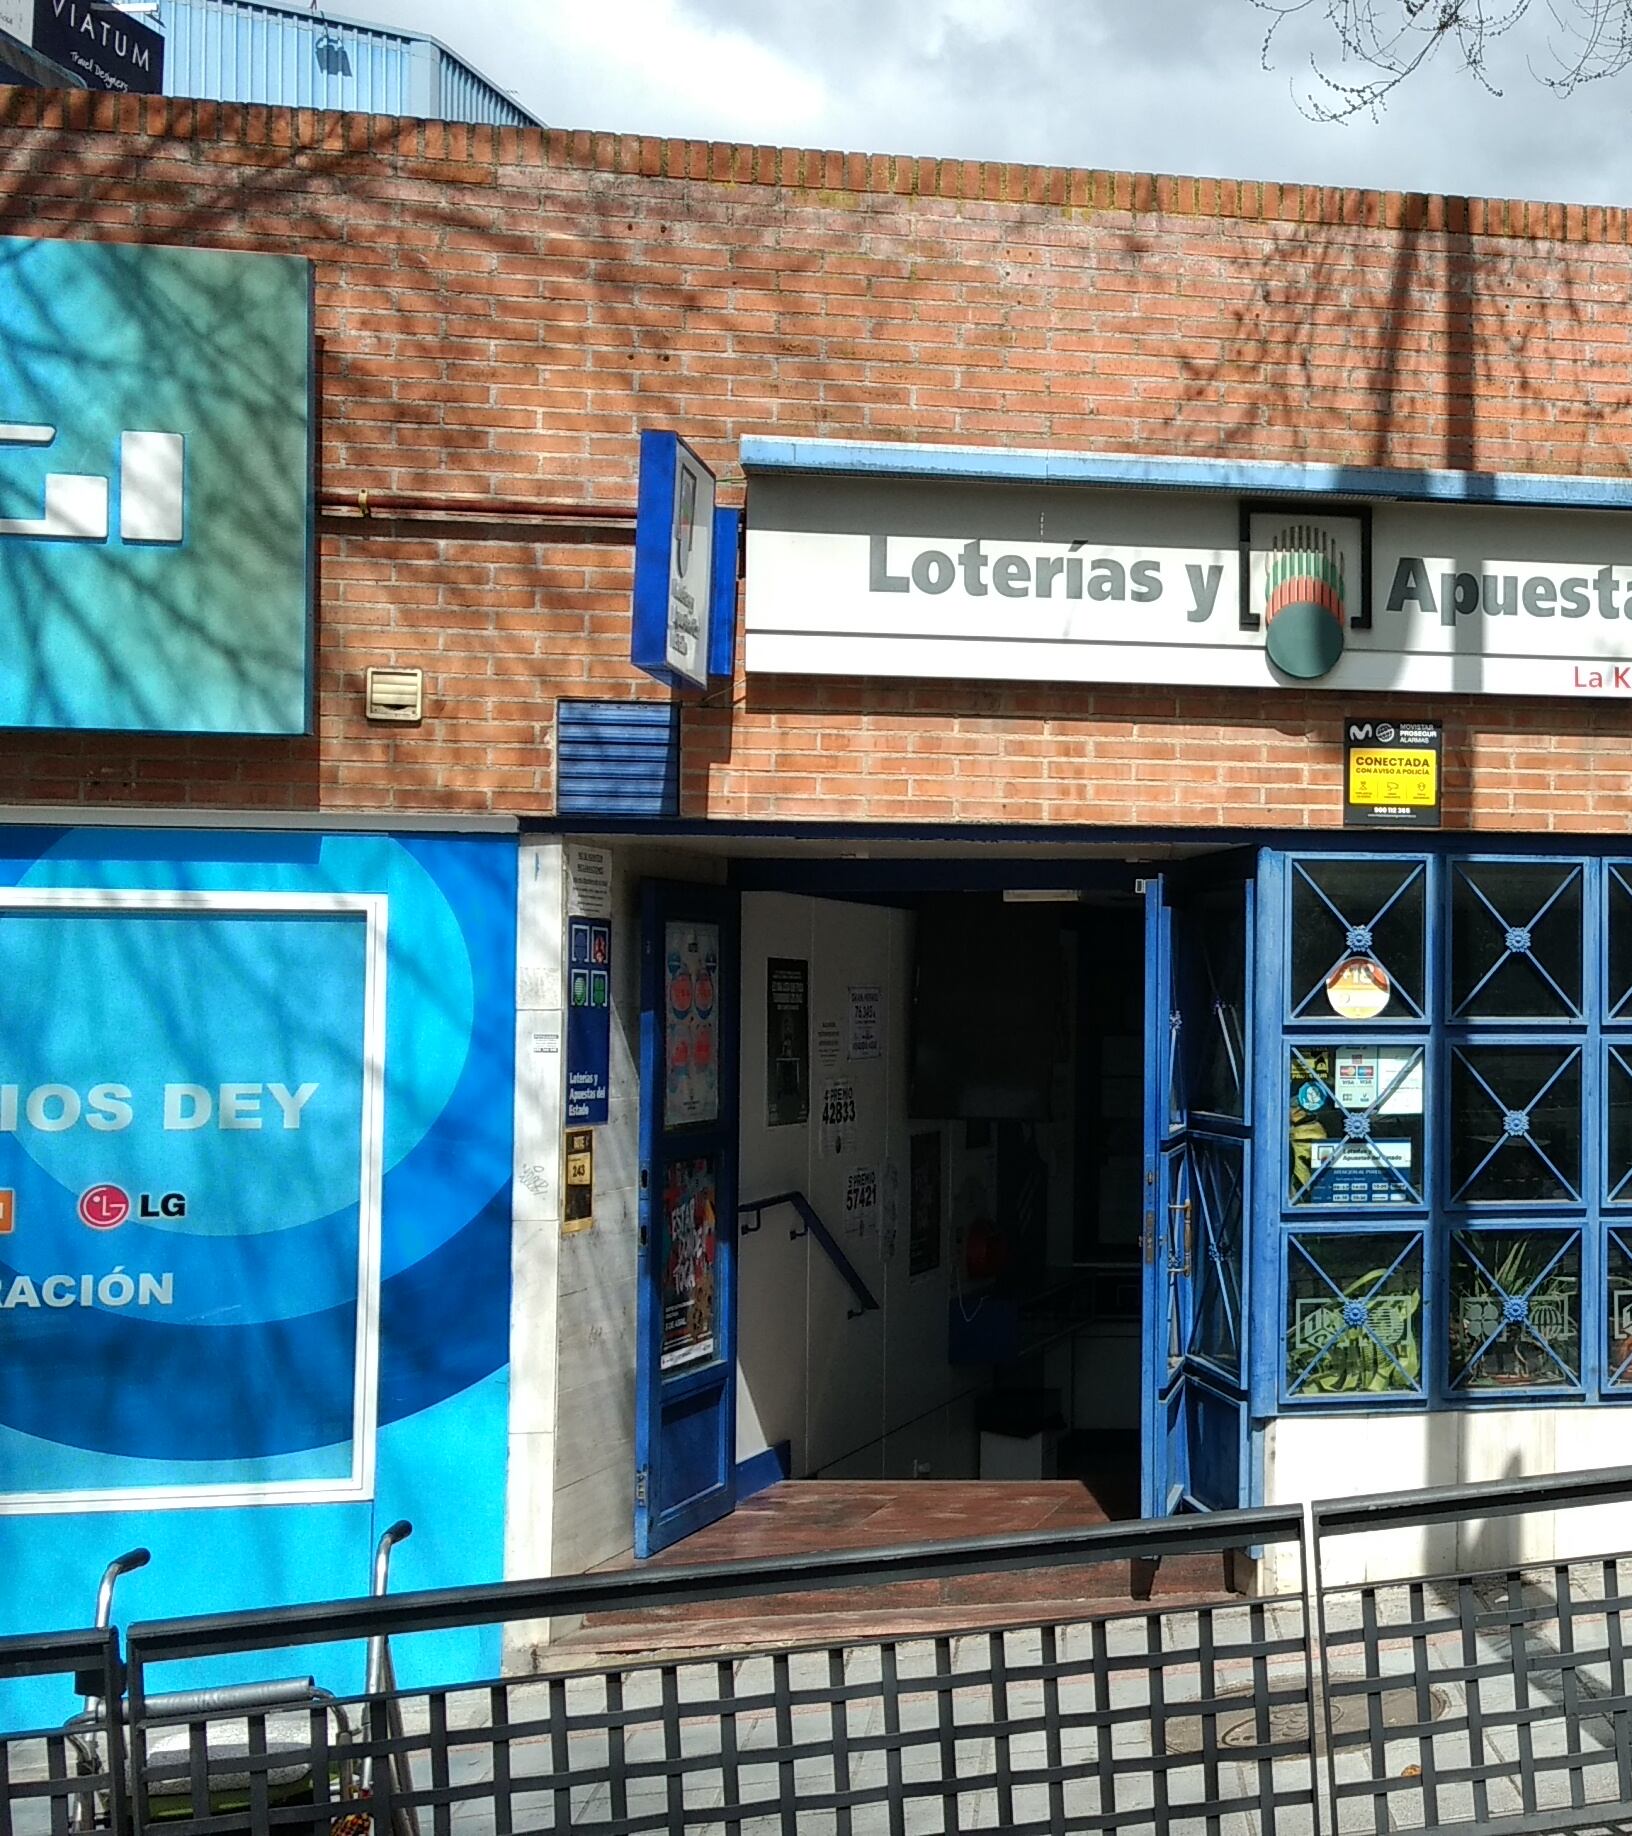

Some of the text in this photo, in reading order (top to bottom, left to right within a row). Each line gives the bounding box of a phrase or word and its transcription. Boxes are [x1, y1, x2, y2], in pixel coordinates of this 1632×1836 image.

[52, 0, 149, 71] VIATUM
[70, 51, 94, 71] Travel
[869, 535, 1224, 622] Loterías y
[1574, 666, 1603, 689] La
[1355, 757, 1430, 767] CONECTADA
[569, 1072, 599, 1087] Loterías y
[569, 1086, 606, 1101] Apuestas del
[830, 1087, 853, 1101] PREMIO
[163, 1082, 320, 1130] DEY
[568, 1104, 589, 1116] Estado
[822, 1100, 856, 1124] 42833
[573, 1165, 585, 1177] 243
[140, 1193, 185, 1217] LG
[846, 1183, 876, 1211] 57421
[0, 1266, 174, 1308] ACIÓN
